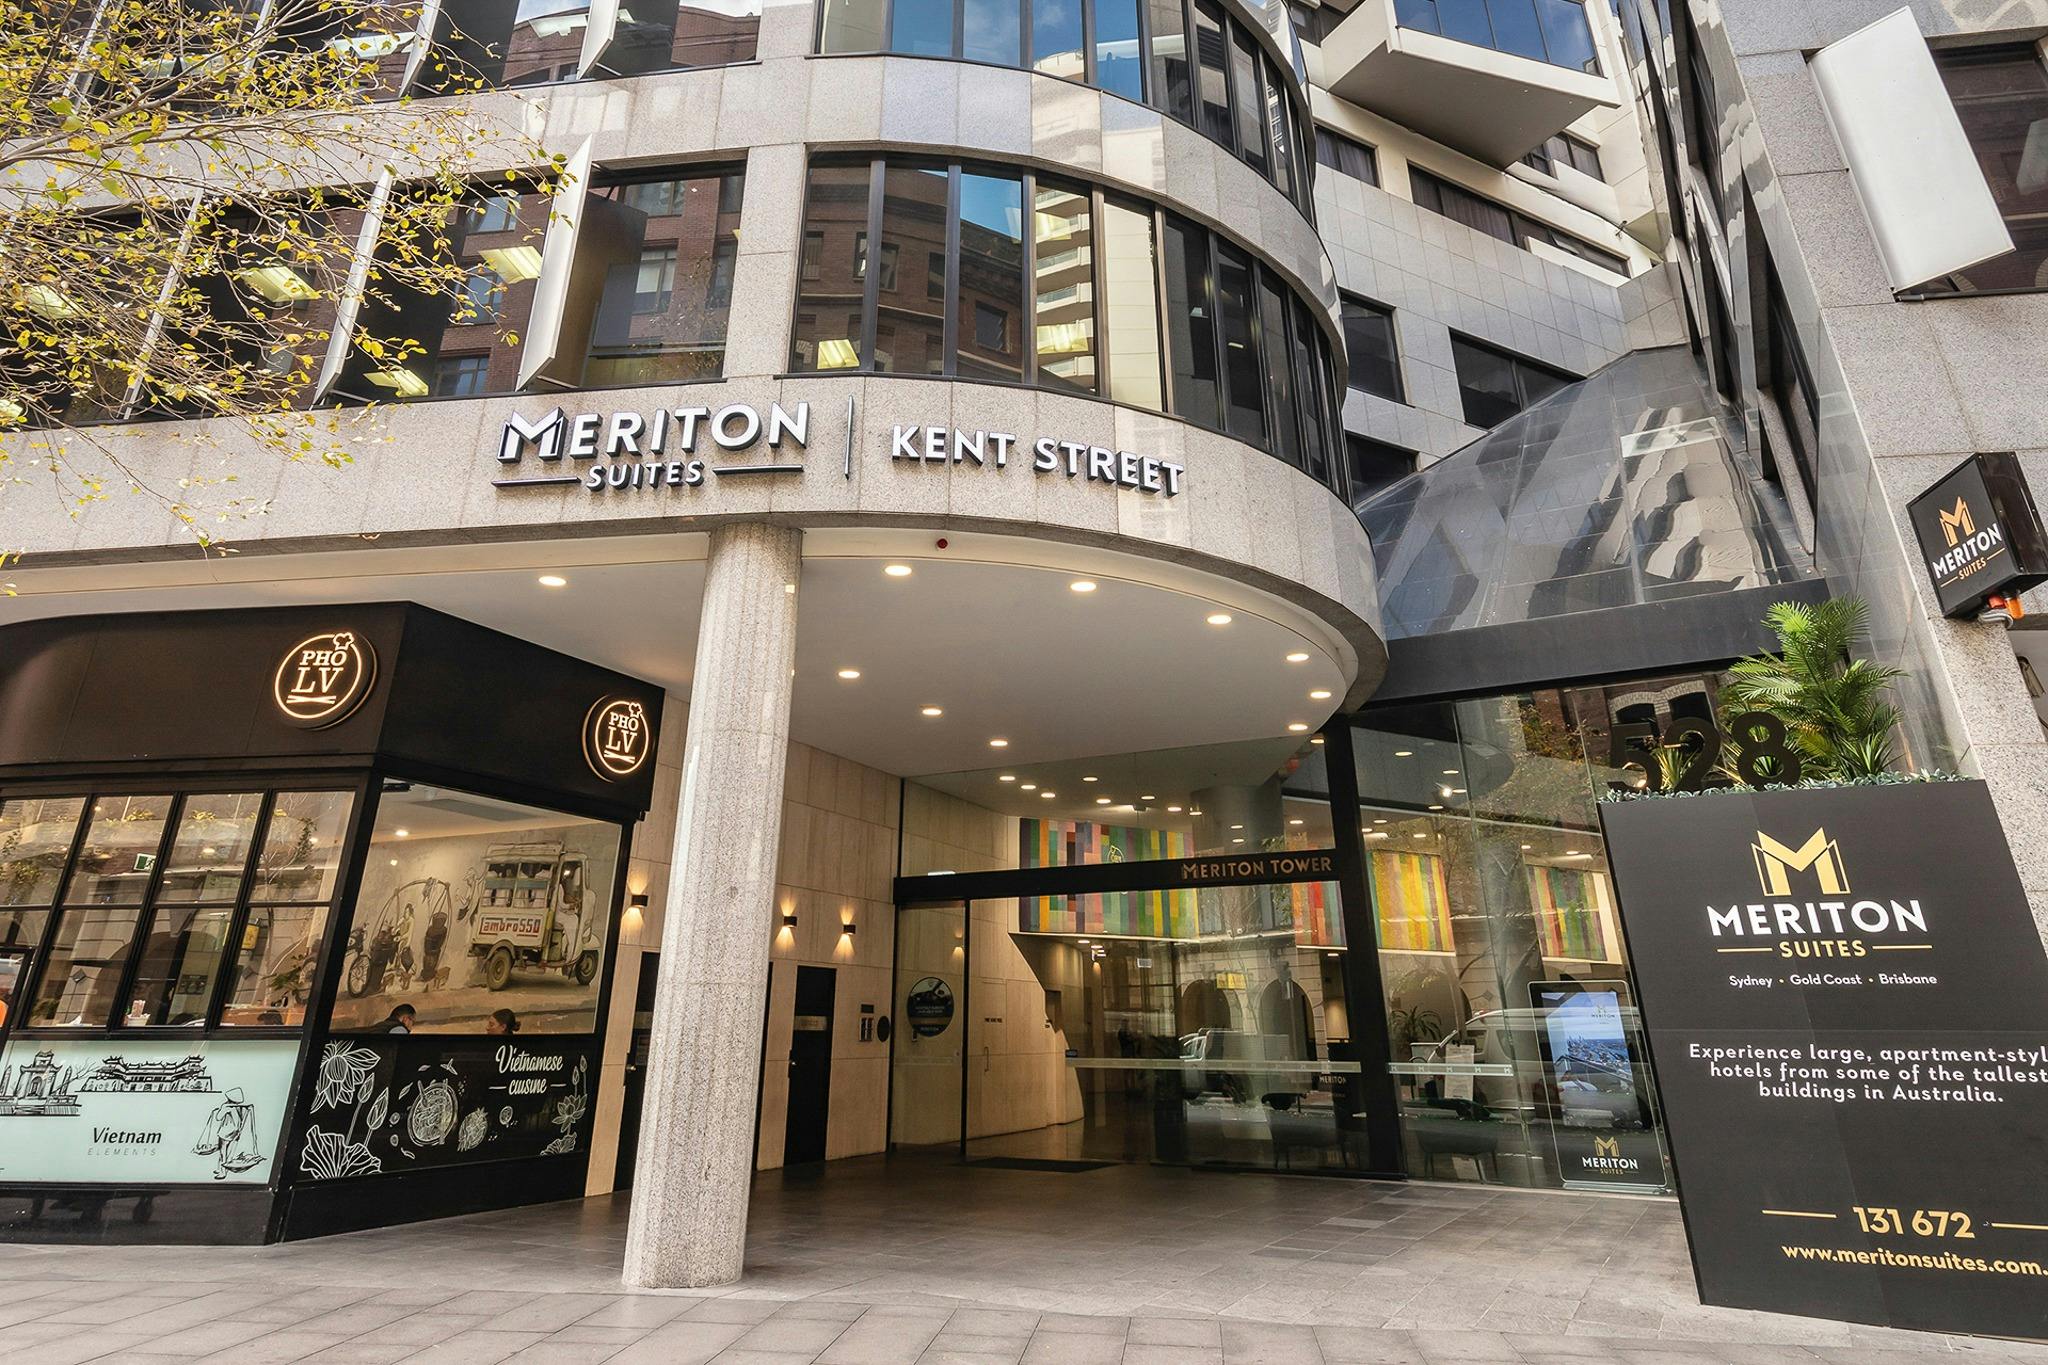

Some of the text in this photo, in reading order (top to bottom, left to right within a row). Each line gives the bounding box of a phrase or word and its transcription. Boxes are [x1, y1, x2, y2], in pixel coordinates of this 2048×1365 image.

[497, 402, 809, 464] MERITON
[892, 425, 1184, 497] KENT STREET
[586, 460, 704, 491] SUITES
[1932, 523, 2002, 579] MERITON
[1958, 557, 1987, 580] SUITES
[291, 667, 344, 693] LV
[605, 726, 637, 753] LV
[1607, 711, 1800, 792] 528
[1183, 856, 1332, 880] MERITON TOWER
[1706, 899, 1928, 936] MERITON
[1779, 940, 1867, 958] SUITES
[1728, 972, 1938, 988] Sydney Gold Coast Brisbane
[495, 1045, 564, 1073] Vietnamese
[1689, 1044, 2048, 1067] Experience large, apartment-styl
[1711, 1062, 2048, 1084] hotels from some of the tallest
[508, 1078, 548, 1095] cuisine
[1759, 1081, 2004, 1103] buildings in Australia.
[93, 1127, 162, 1144] Vietnam
[87, 1147, 156, 1156] ELEMENTS
[1582, 1156, 1639, 1170] MERITON
[1852, 1206, 1976, 1239] 131 672
[1781, 1245, 2048, 1276] www.meritonsuites.com.
